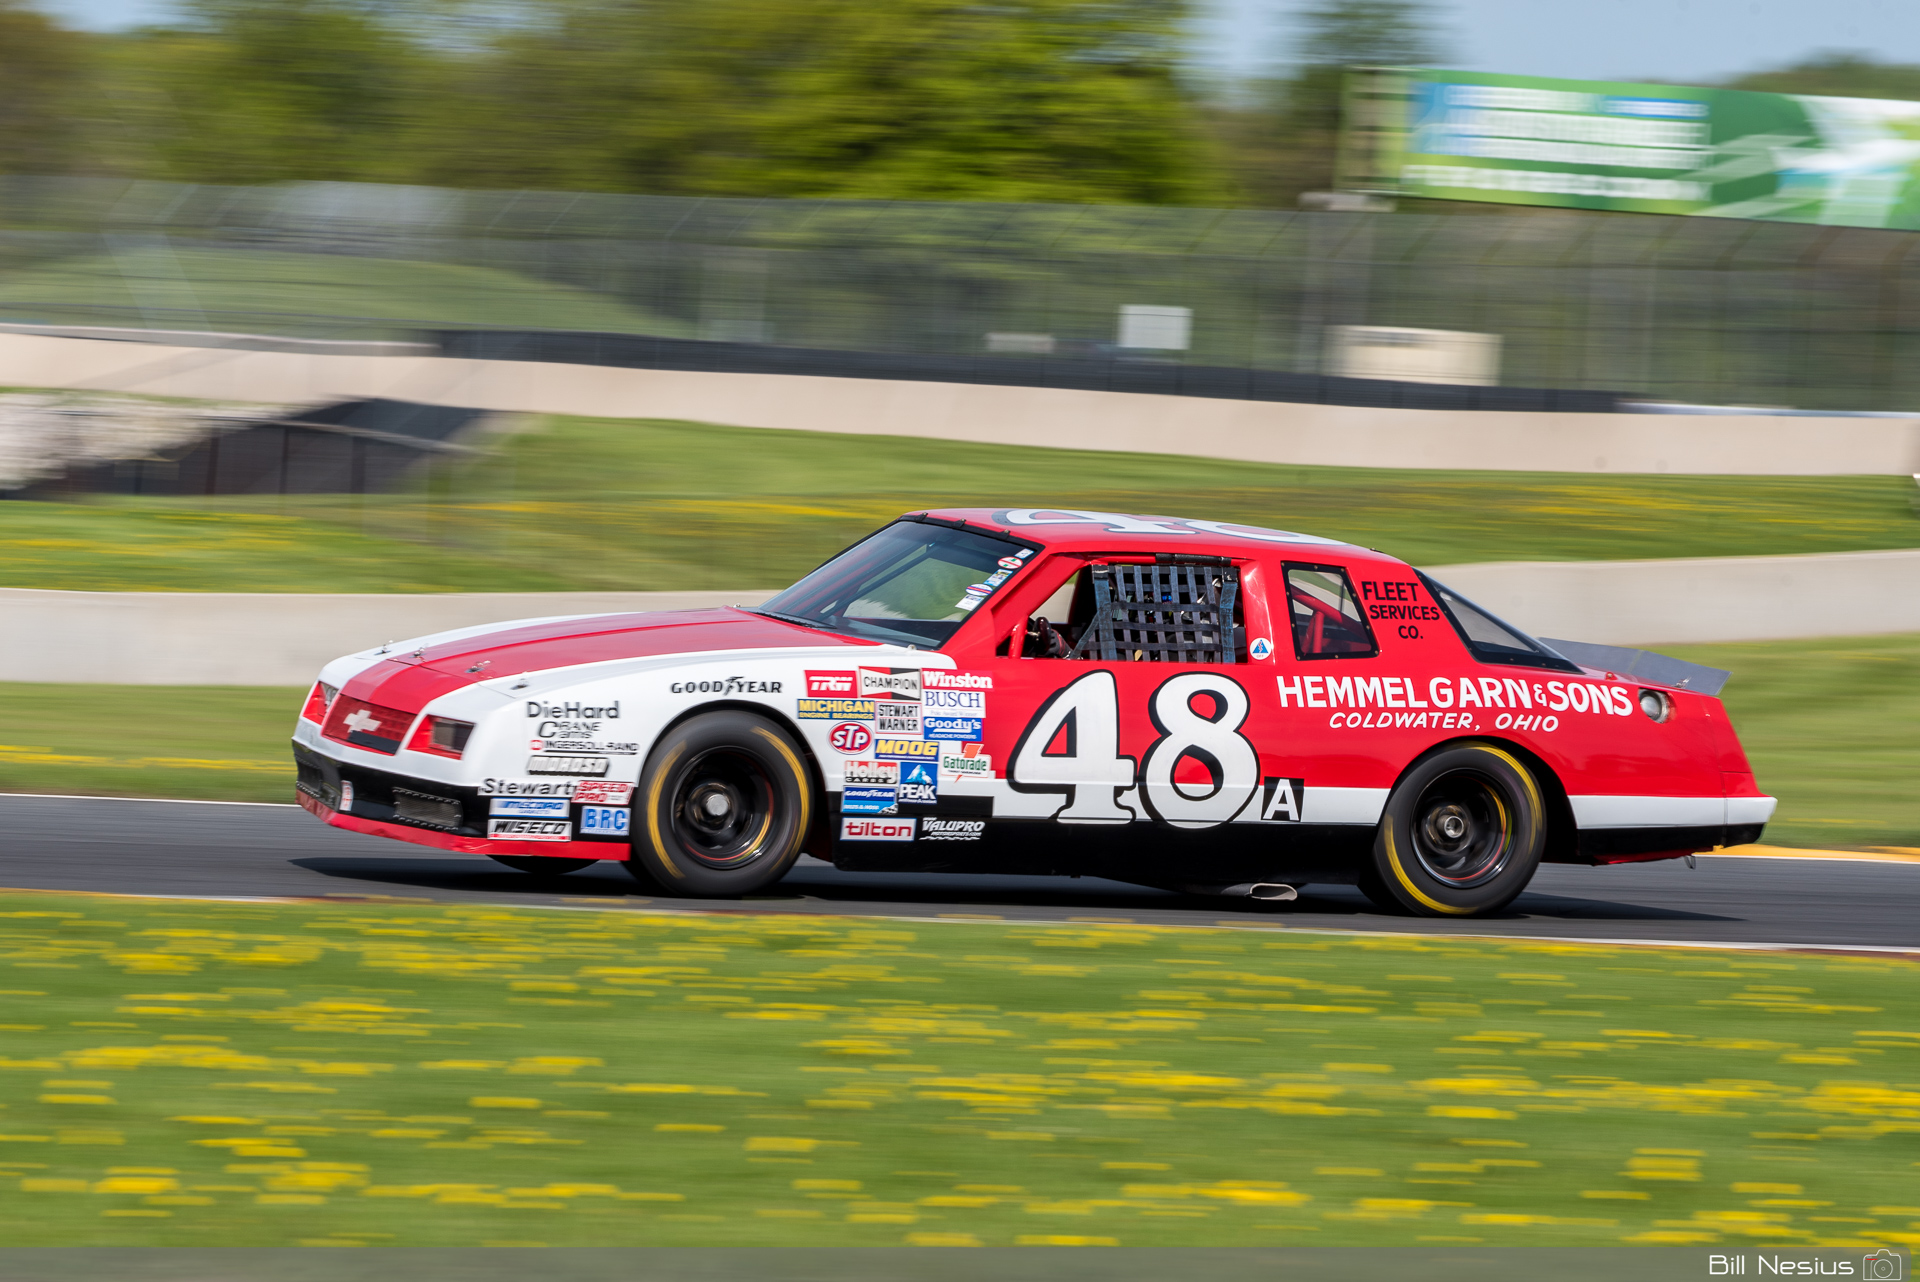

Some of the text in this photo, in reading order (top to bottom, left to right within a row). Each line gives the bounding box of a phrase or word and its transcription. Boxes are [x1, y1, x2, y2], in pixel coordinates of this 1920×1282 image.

[1361, 581, 1419, 602] FLEET
[1369, 604, 1440, 621] SERVICES
[1398, 625, 1424, 640] CO.
[670, 677, 783, 695] GOODYEAR
[809, 675, 853, 691] TRW
[863, 676, 918, 691] CHAMPION
[922, 670, 994, 689] Winston
[799, 700, 875, 713] MICHIGAN
[924, 690, 982, 708] BUSCH
[526, 700, 620, 719] DieHard
[878, 704, 919, 717] STEWART
[879, 718, 919, 731] WARNER
[924, 717, 982, 733] Goody's
[1329, 711, 1559, 732] COLDWATER, OHIO
[832, 725, 869, 750] STP
[876, 740, 938, 756] MOOG
[1006, 669, 1300, 829] 48 A
[846, 761, 897, 783] Holley
[943, 756, 987, 772] Gatorade
[483, 777, 574, 796] Stewart
[579, 780, 629, 793] SPEED
[899, 783, 936, 799] PEAK
[575, 792, 609, 803] PRO
[587, 808, 627, 830] BRC
[922, 819, 986, 833] VALUPRO
[495, 820, 567, 835] WISECO
[845, 821, 913, 837] tilton
